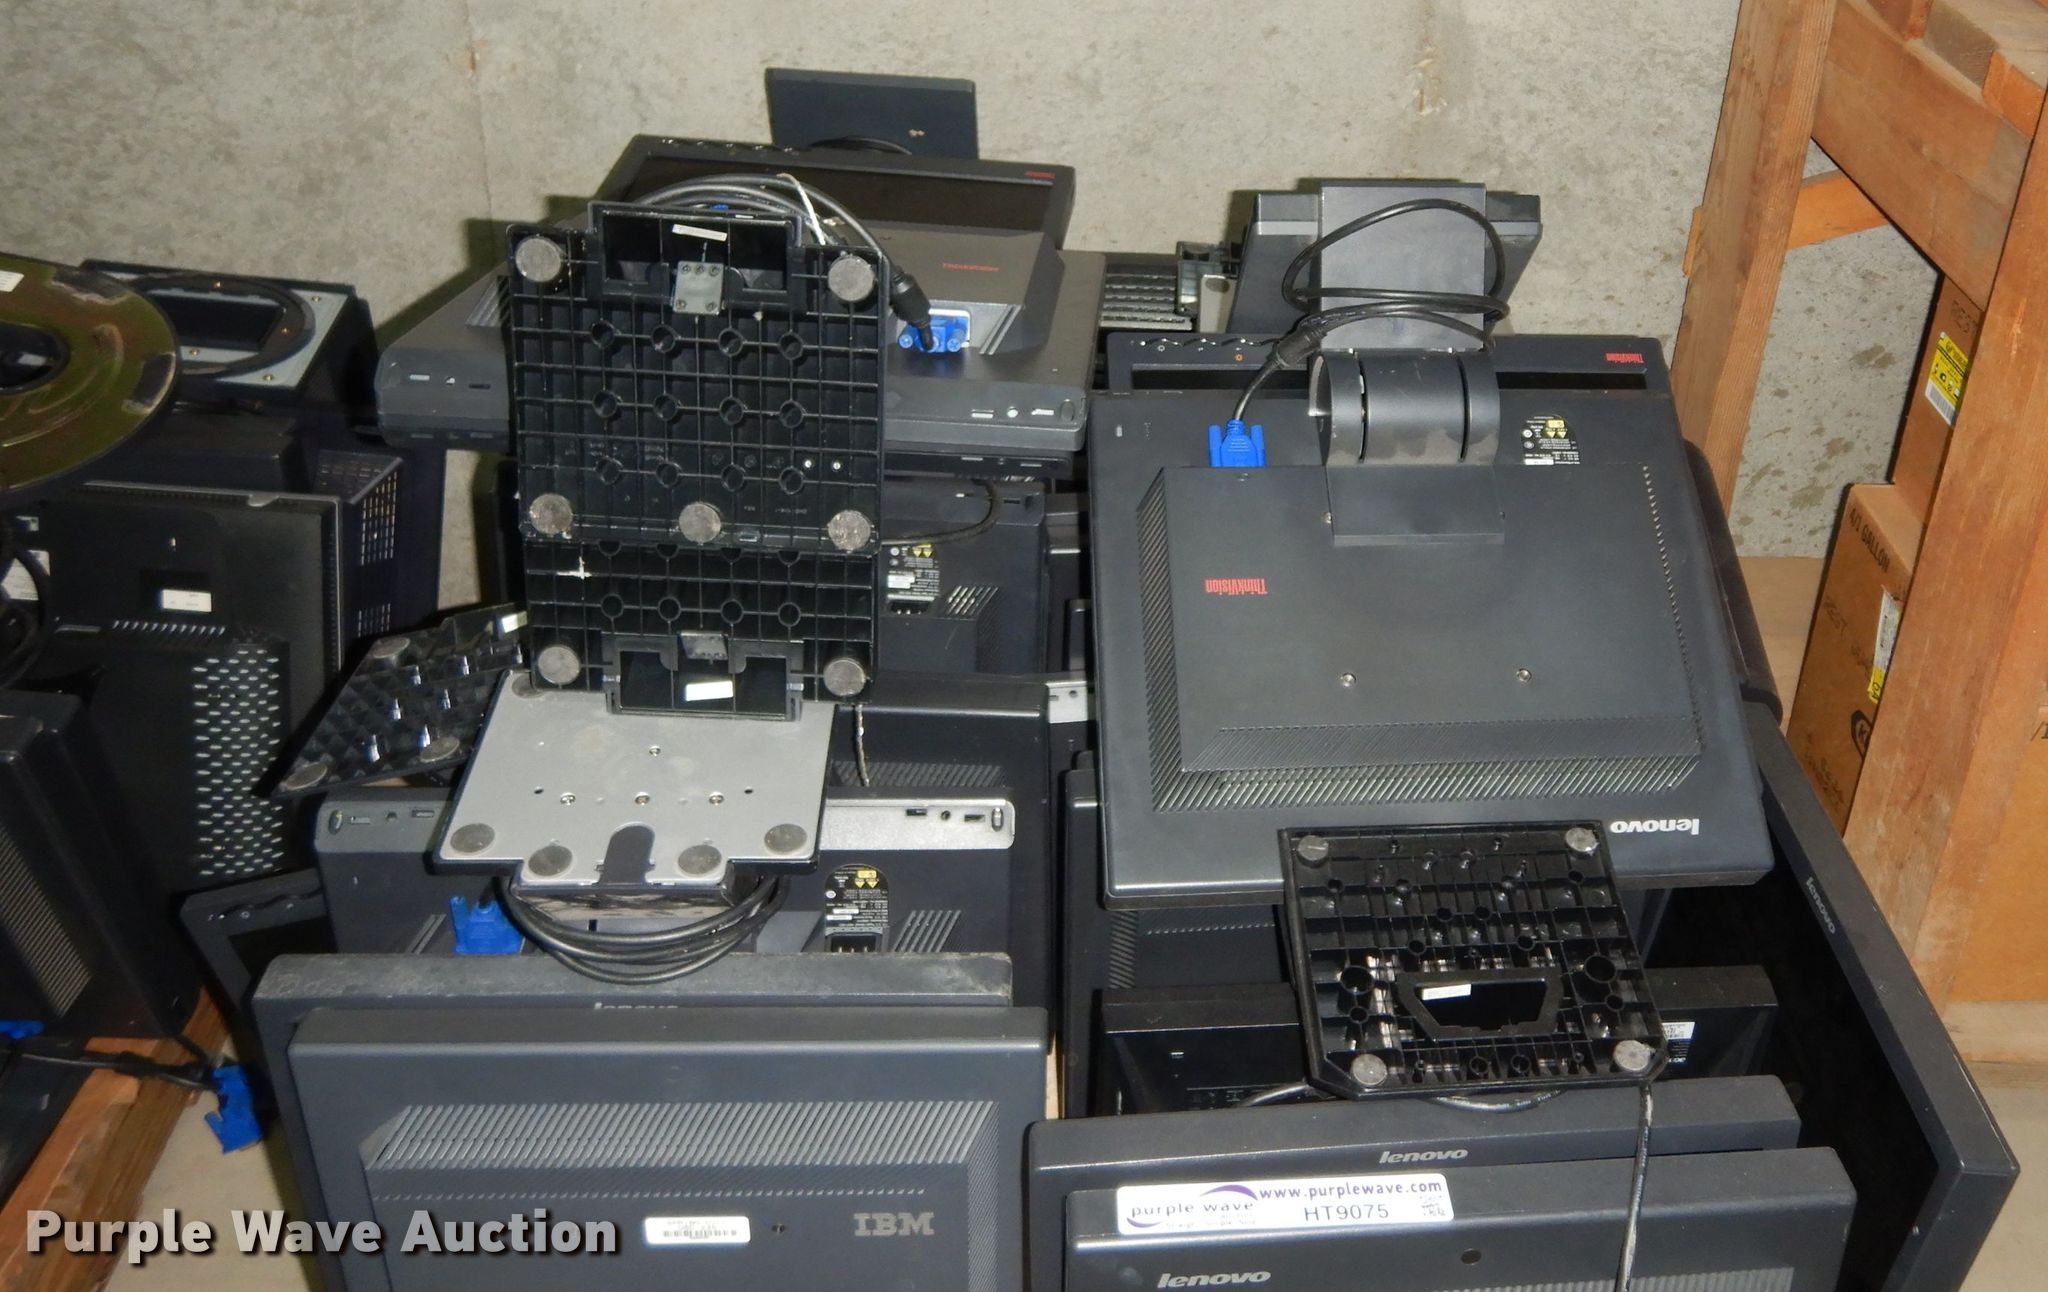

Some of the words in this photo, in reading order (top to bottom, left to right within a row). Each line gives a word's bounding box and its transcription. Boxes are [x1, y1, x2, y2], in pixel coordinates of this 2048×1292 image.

[1204, 578, 1269, 596] ThinkVision
[1610, 818, 1700, 836] lenovo
[1805, 876, 1836, 935] lenovo
[1379, 1149, 1469, 1165] lenovo
[1259, 1181, 1442, 1201] www.purplewave.com
[1130, 1202, 1195, 1218] purple
[1203, 1201, 1254, 1213] wave
[1304, 1203, 1390, 1222] HT9075
[853, 1212, 935, 1236] IBM
[1157, 1271, 1272, 1288] lenovo
